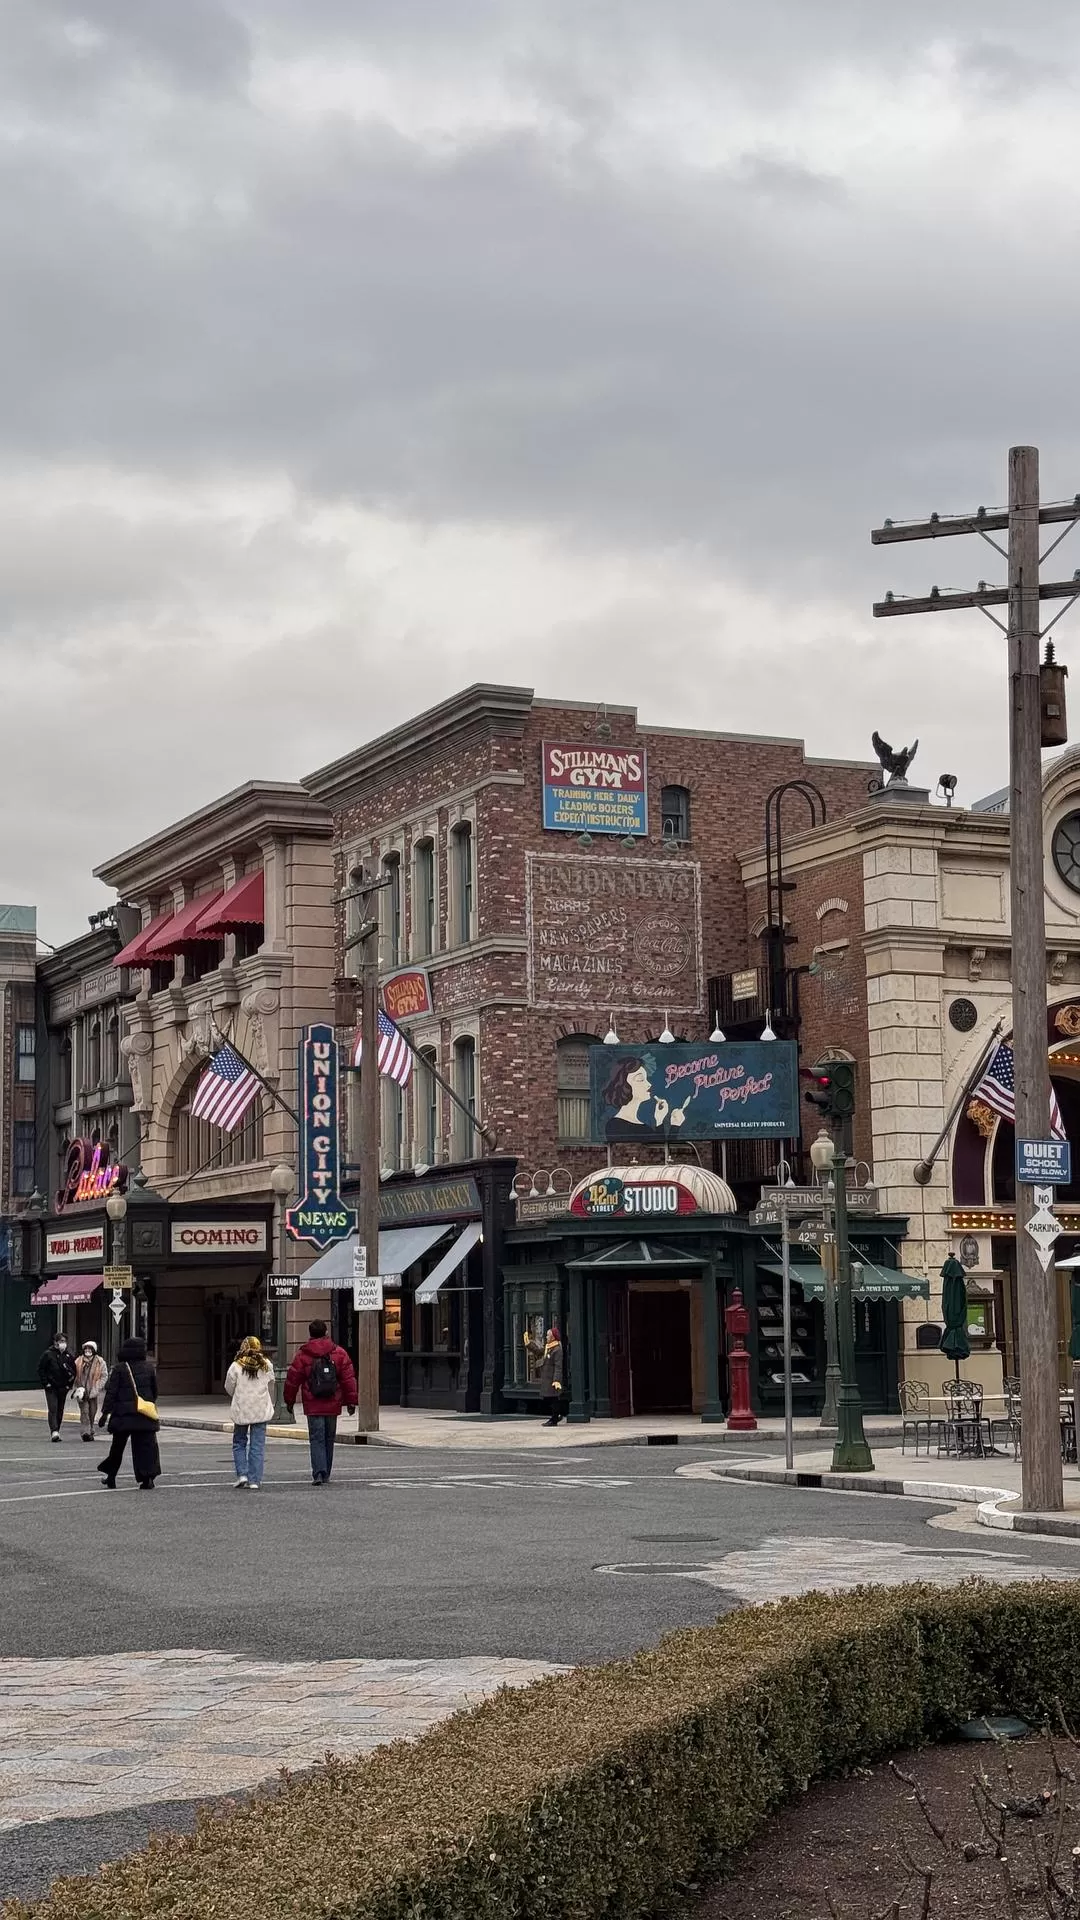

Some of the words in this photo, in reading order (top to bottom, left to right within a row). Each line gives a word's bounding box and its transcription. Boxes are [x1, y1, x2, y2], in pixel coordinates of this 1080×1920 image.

[550, 749, 641, 781] STILLMAN'S
[570, 768, 622, 788] GYM
[552, 788, 591, 800] TRAINING
[594, 791, 614, 801] HERE
[560, 800, 597, 812] LEADING
[599, 803, 634, 815] BOXERS
[553, 812, 585, 824] EXPERT
[587, 814, 640, 828] INSTRUCTION
[539, 906, 627, 946] NEWSPAPERS
[539, 954, 623, 974] MAGAZINES
[397, 995, 419, 1015] GYM
[665, 1054, 719, 1089] Become
[312, 1042, 331, 1128] UNION
[692, 1064, 745, 1099] Picture
[718, 1072, 773, 1112] Perfect
[1023, 1143, 1063, 1159] QUIET
[312, 1136, 332, 1205] CITY
[1026, 1159, 1062, 1168] SCHOOL
[1041, 1168, 1068, 1176] SLOWLY
[396, 1190, 430, 1216] NEWS
[430, 1183, 473, 1211] AGENCY
[589, 1185, 618, 1206] 42nd
[623, 1186, 677, 1213] STUDIO
[769, 1193, 822, 1204] GREETING
[1038, 1194, 1049, 1204] NO
[522, 1202, 548, 1214] GREETING
[298, 1212, 347, 1226] NEWS
[1029, 1223, 1060, 1232] PARKING
[180, 1229, 259, 1245] COMING
[798, 1232, 817, 1243] 42ND
[823, 1233, 837, 1244] ST.
[270, 1278, 299, 1287] LOADING
[275, 1287, 293, 1296] ZONE
[358, 1289, 378, 1297] AWAY
[358, 1297, 379, 1306] ZONE
